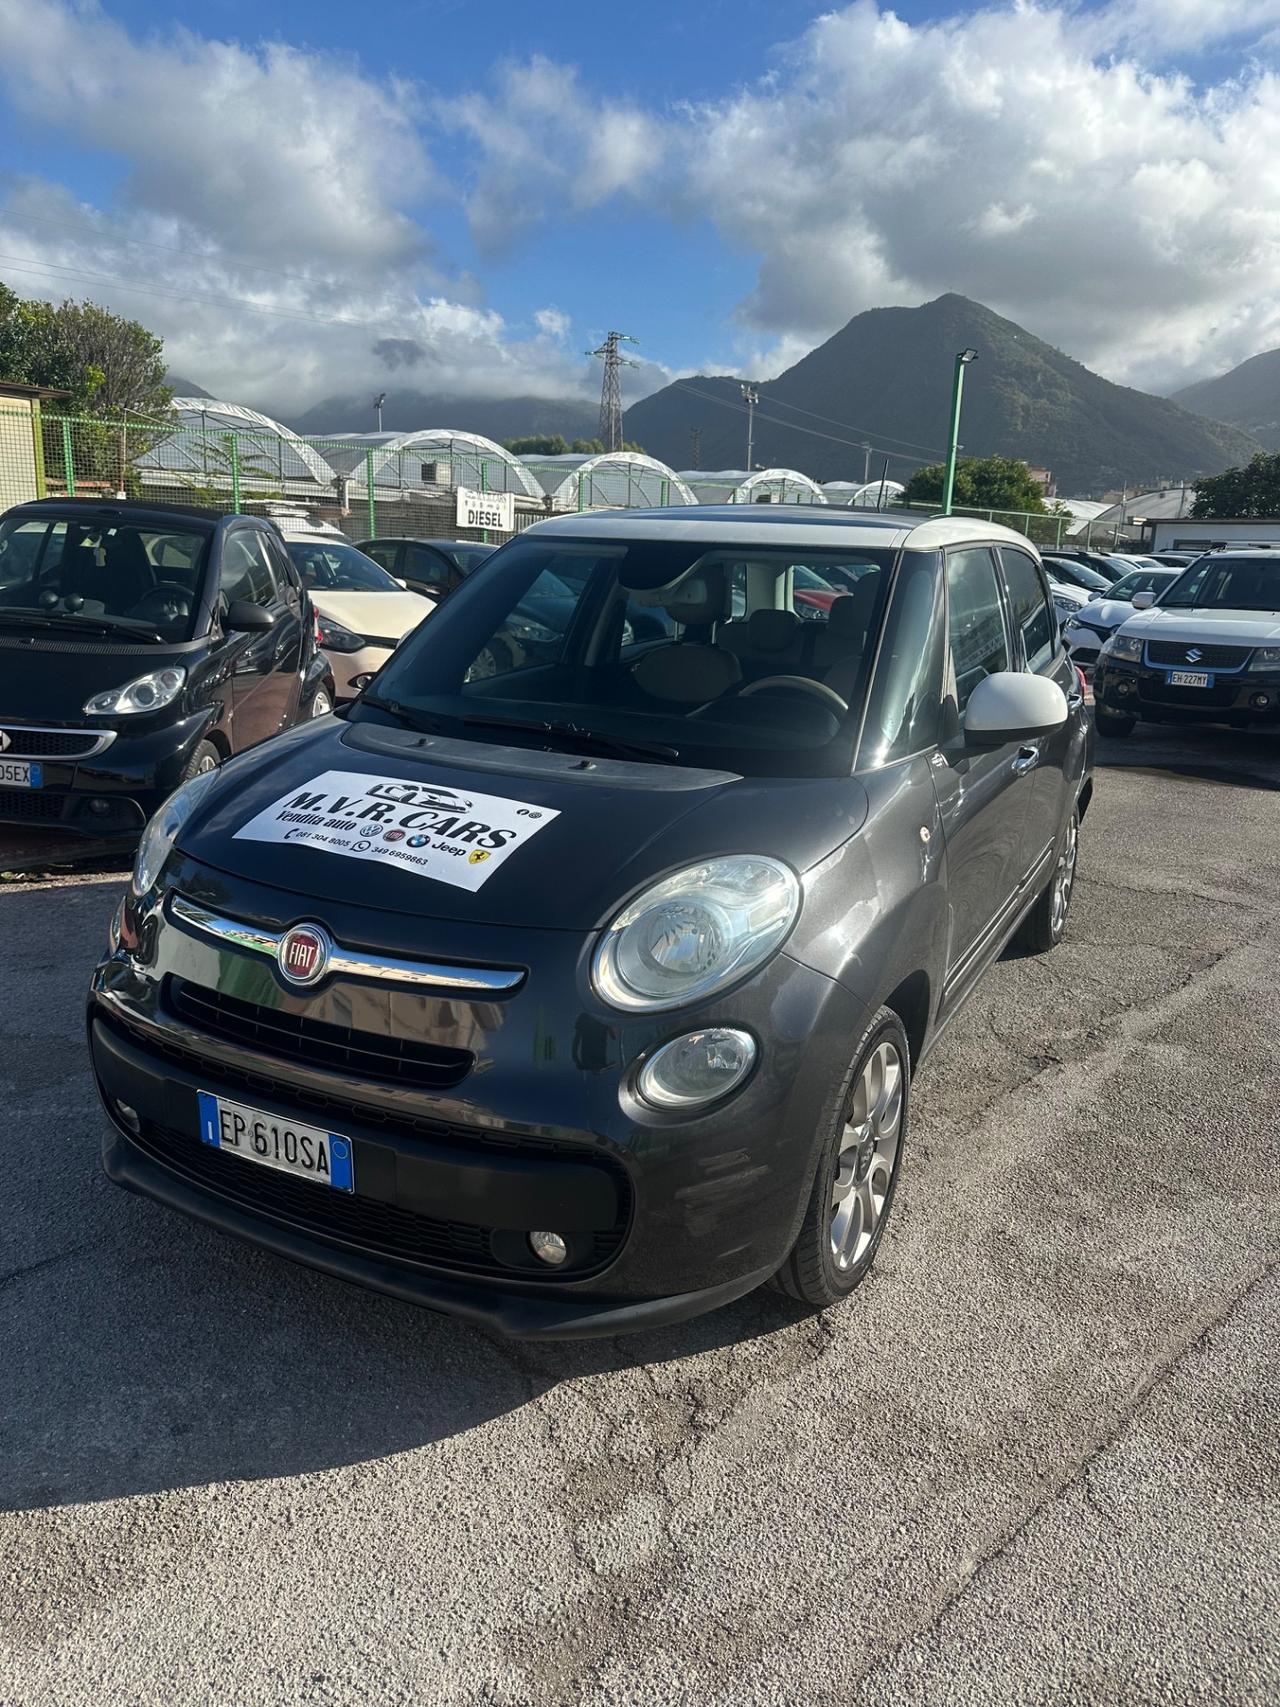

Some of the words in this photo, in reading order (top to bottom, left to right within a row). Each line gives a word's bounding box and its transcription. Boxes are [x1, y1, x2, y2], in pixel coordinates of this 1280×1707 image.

[468, 510, 503, 527] DIESEL
[1172, 673, 1182, 683] EH
[1183, 674, 1207, 685] 227MY
[276, 811, 326, 826] Vendita
[323, 818, 357, 831] auto
[432, 842, 467, 857] Jeep
[289, 942, 315, 968] FIAT
[219, 1109, 246, 1146] EP
[254, 1122, 330, 1175] 610SA
